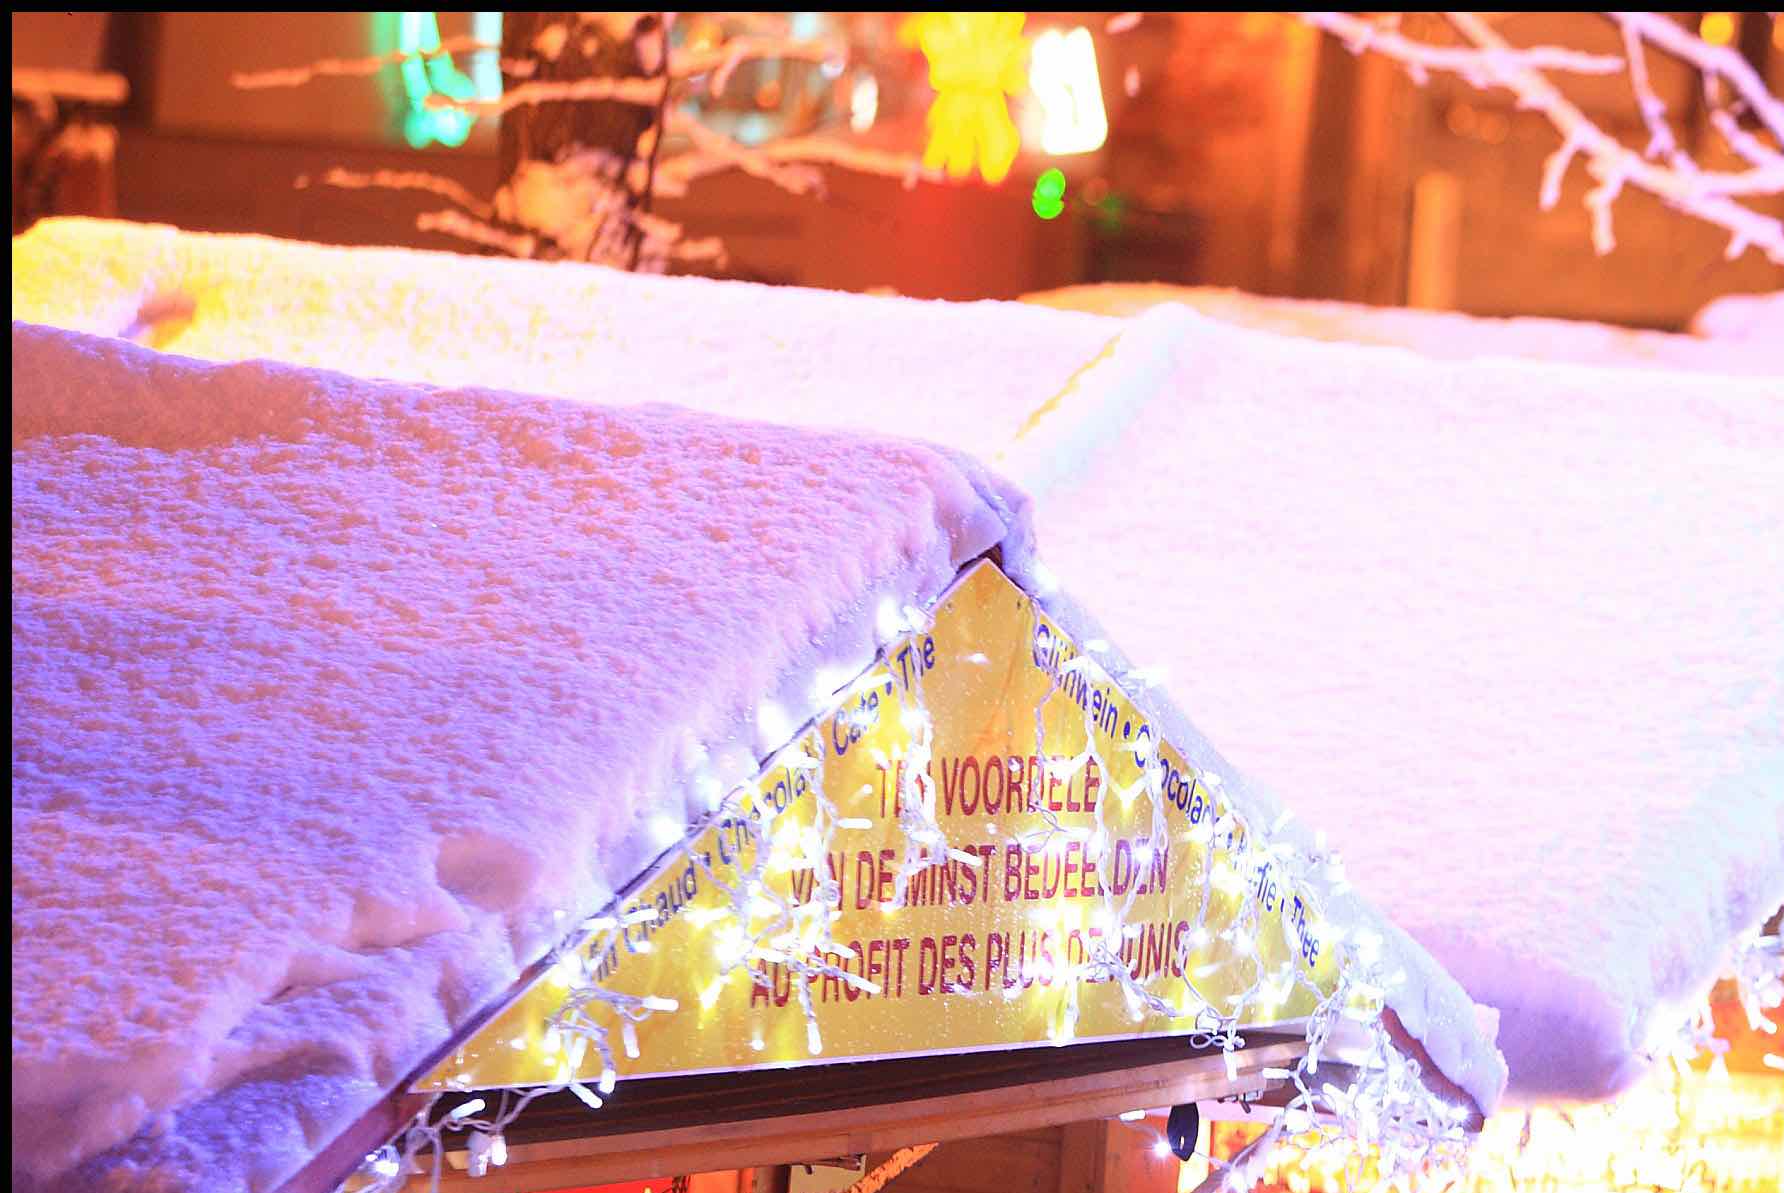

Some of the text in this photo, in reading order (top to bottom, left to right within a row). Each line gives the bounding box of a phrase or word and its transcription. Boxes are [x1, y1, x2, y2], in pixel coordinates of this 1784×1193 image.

[941, 754, 1103, 817] VOORDELE
[790, 850, 845, 912] VN
[855, 848, 896, 911] DE
[904, 843, 998, 908] MINST
[751, 956, 792, 1009] AU
[806, 936, 911, 1004] PROFIT
[917, 932, 978, 996] DES
[984, 928, 1055, 992] PLUS
